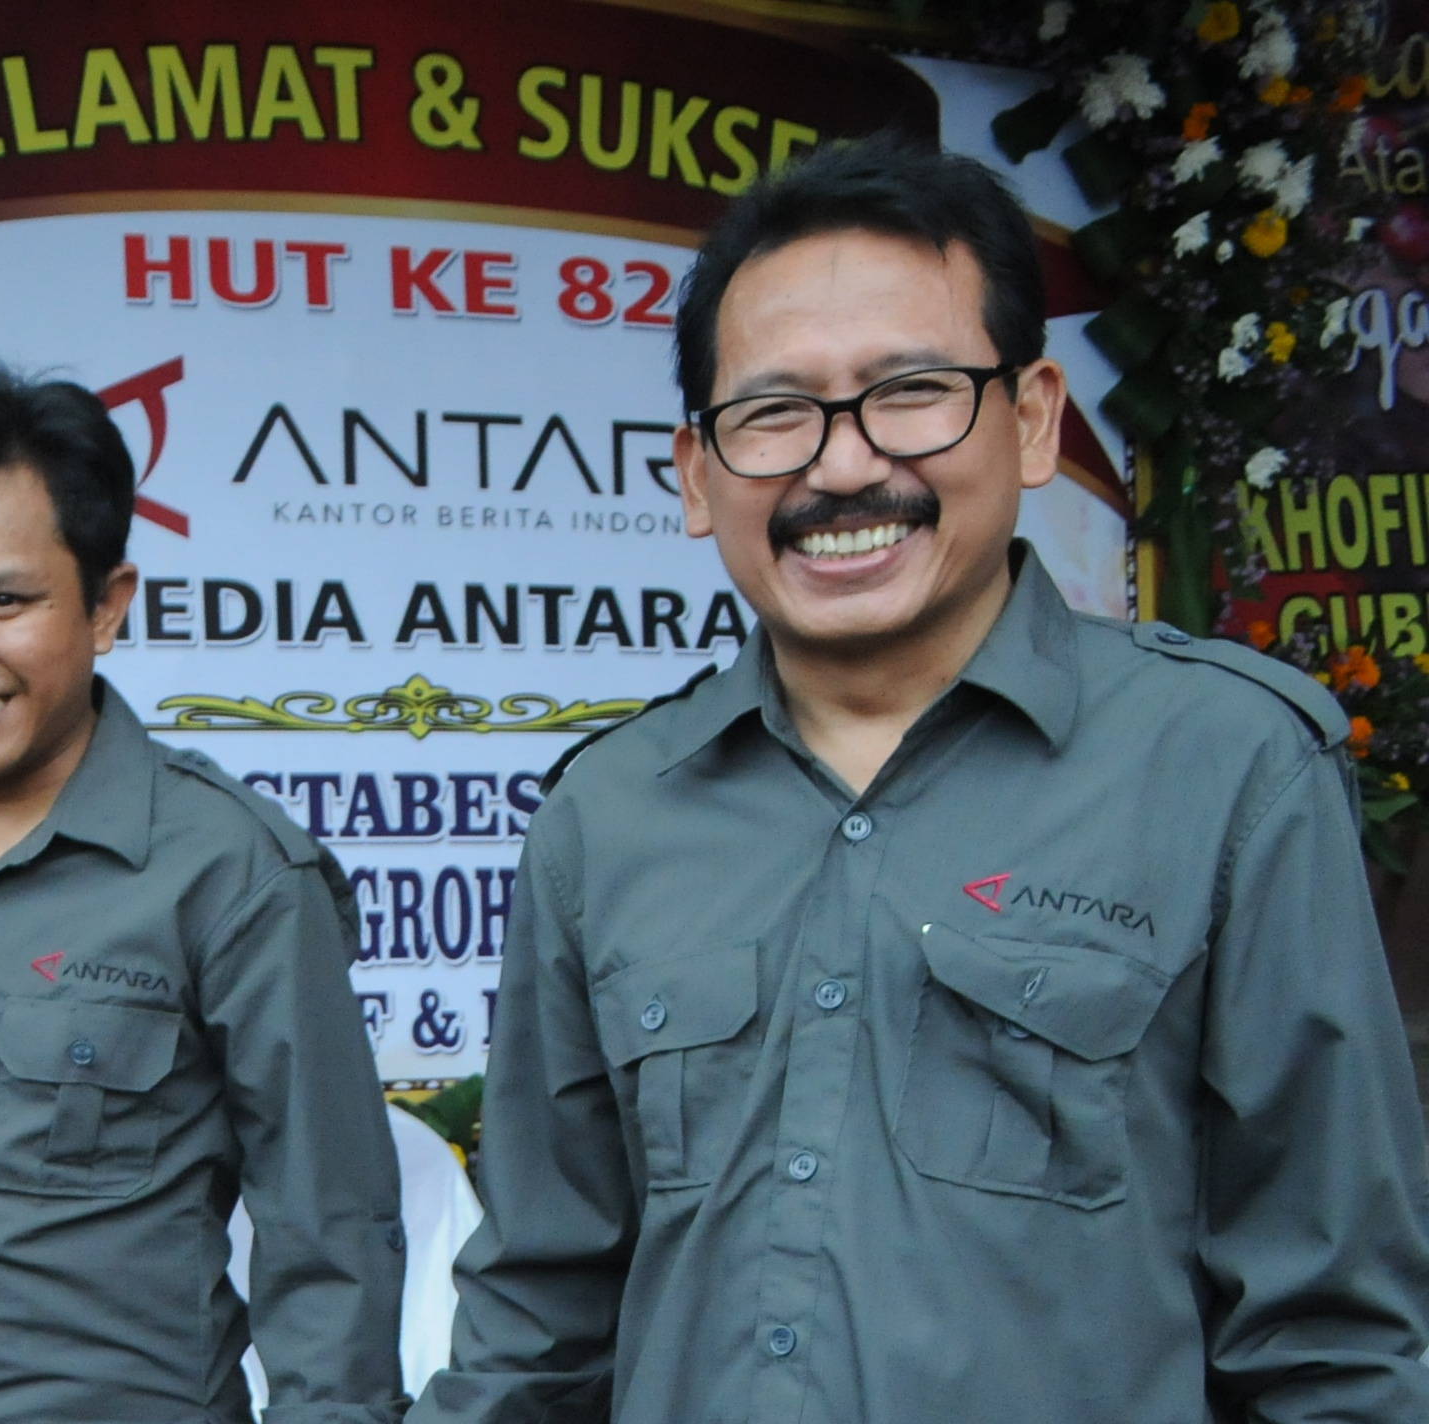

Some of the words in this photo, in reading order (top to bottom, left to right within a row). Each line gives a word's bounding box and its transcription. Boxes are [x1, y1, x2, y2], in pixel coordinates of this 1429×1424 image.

[409, 53, 483, 150] &
[518, 66, 831, 198] SUKSE
[122, 233, 347, 308] HUT
[390, 246, 520, 318] KE
[557, 255, 676, 327] 82
[232, 402, 682, 498] ANTAR
[272, 501, 420, 527] KANTOR
[437, 503, 554, 530] BERITA
[571, 510, 682, 535] INDON
[1235, 472, 1429, 573] KHOFI
[121, 578, 366, 644] EDIA
[393, 581, 748, 649] ANTARA
[1010, 885, 1156, 938] ANTARA
[62, 961, 170, 993] ANTARA
[412, 988, 461, 1049] &
